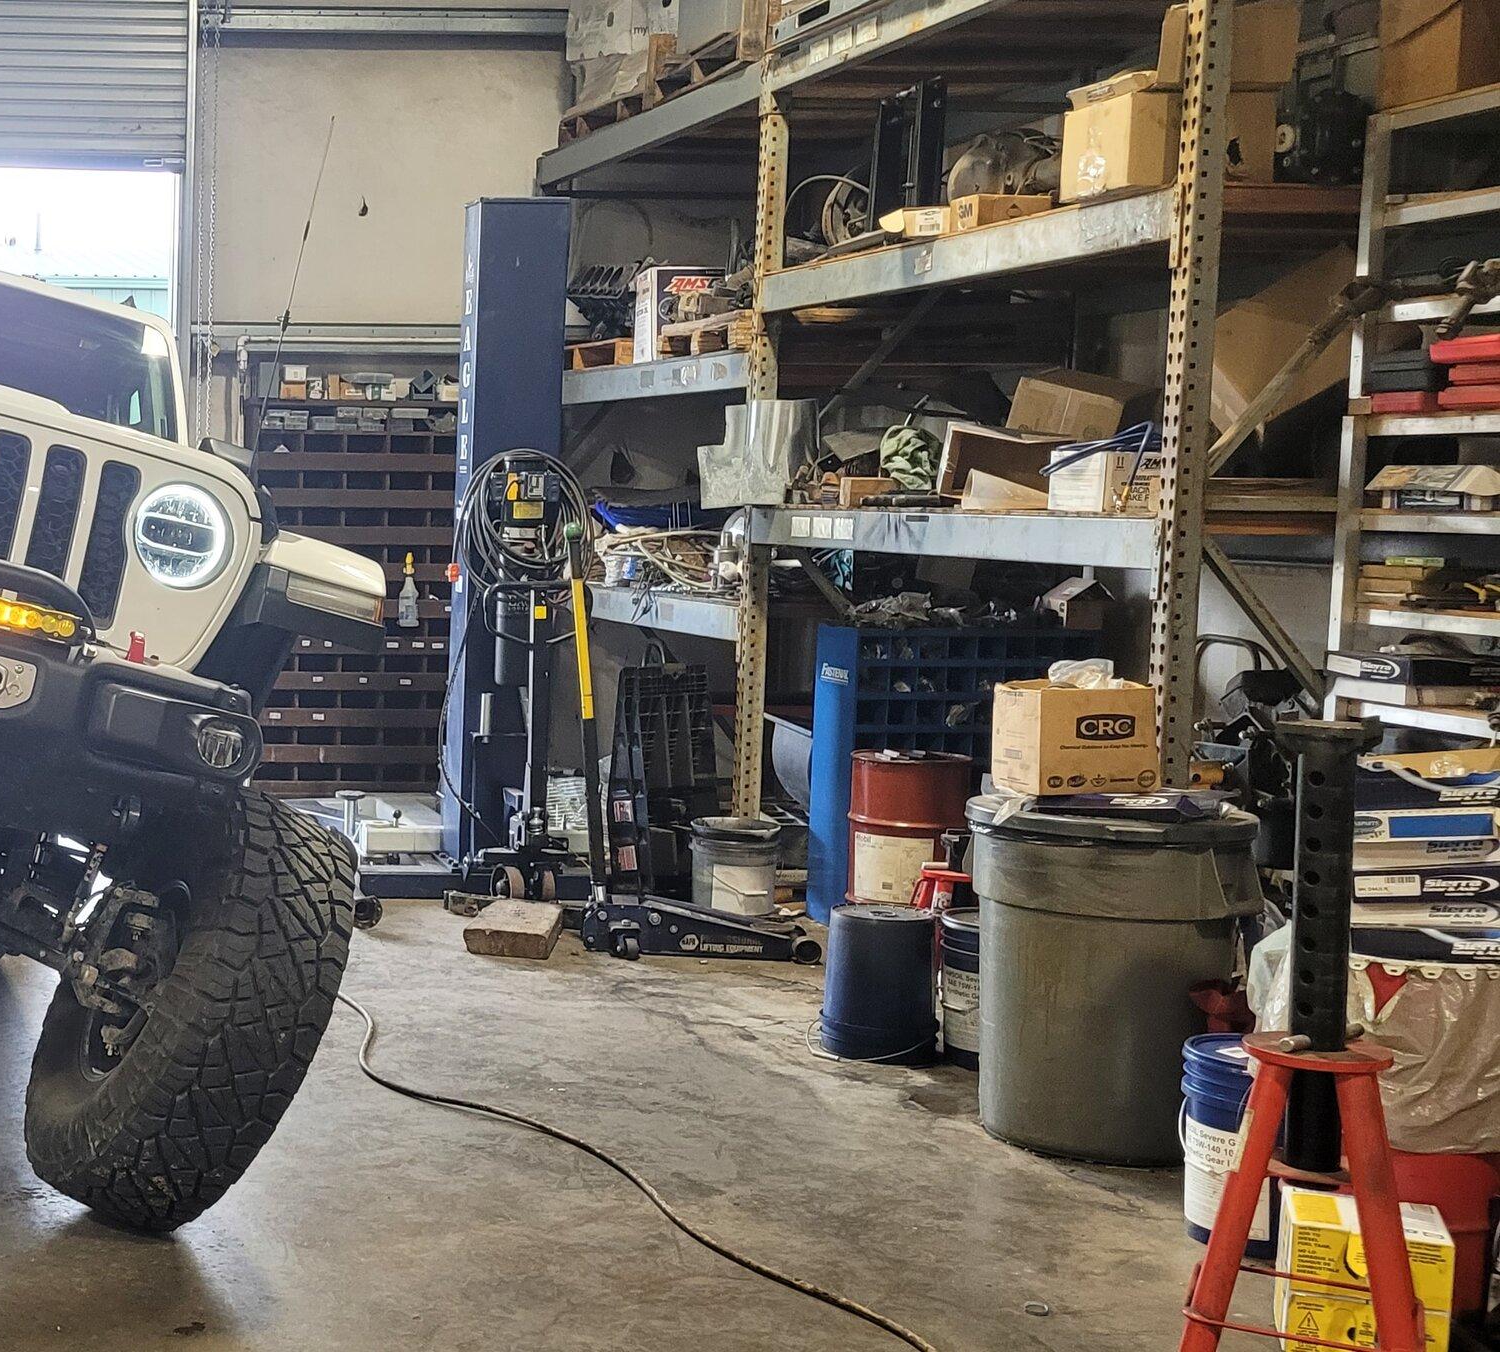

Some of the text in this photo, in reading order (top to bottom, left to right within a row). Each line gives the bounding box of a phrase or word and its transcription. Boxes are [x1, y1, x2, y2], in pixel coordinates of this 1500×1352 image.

[1079, 718, 1133, 736] CRC
[1424, 879, 1483, 888] Sierra
[1429, 906, 1488, 914] Sierra
[1199, 1128, 1226, 1146] Severe
[1204, 1153, 1225, 1167] Gear
